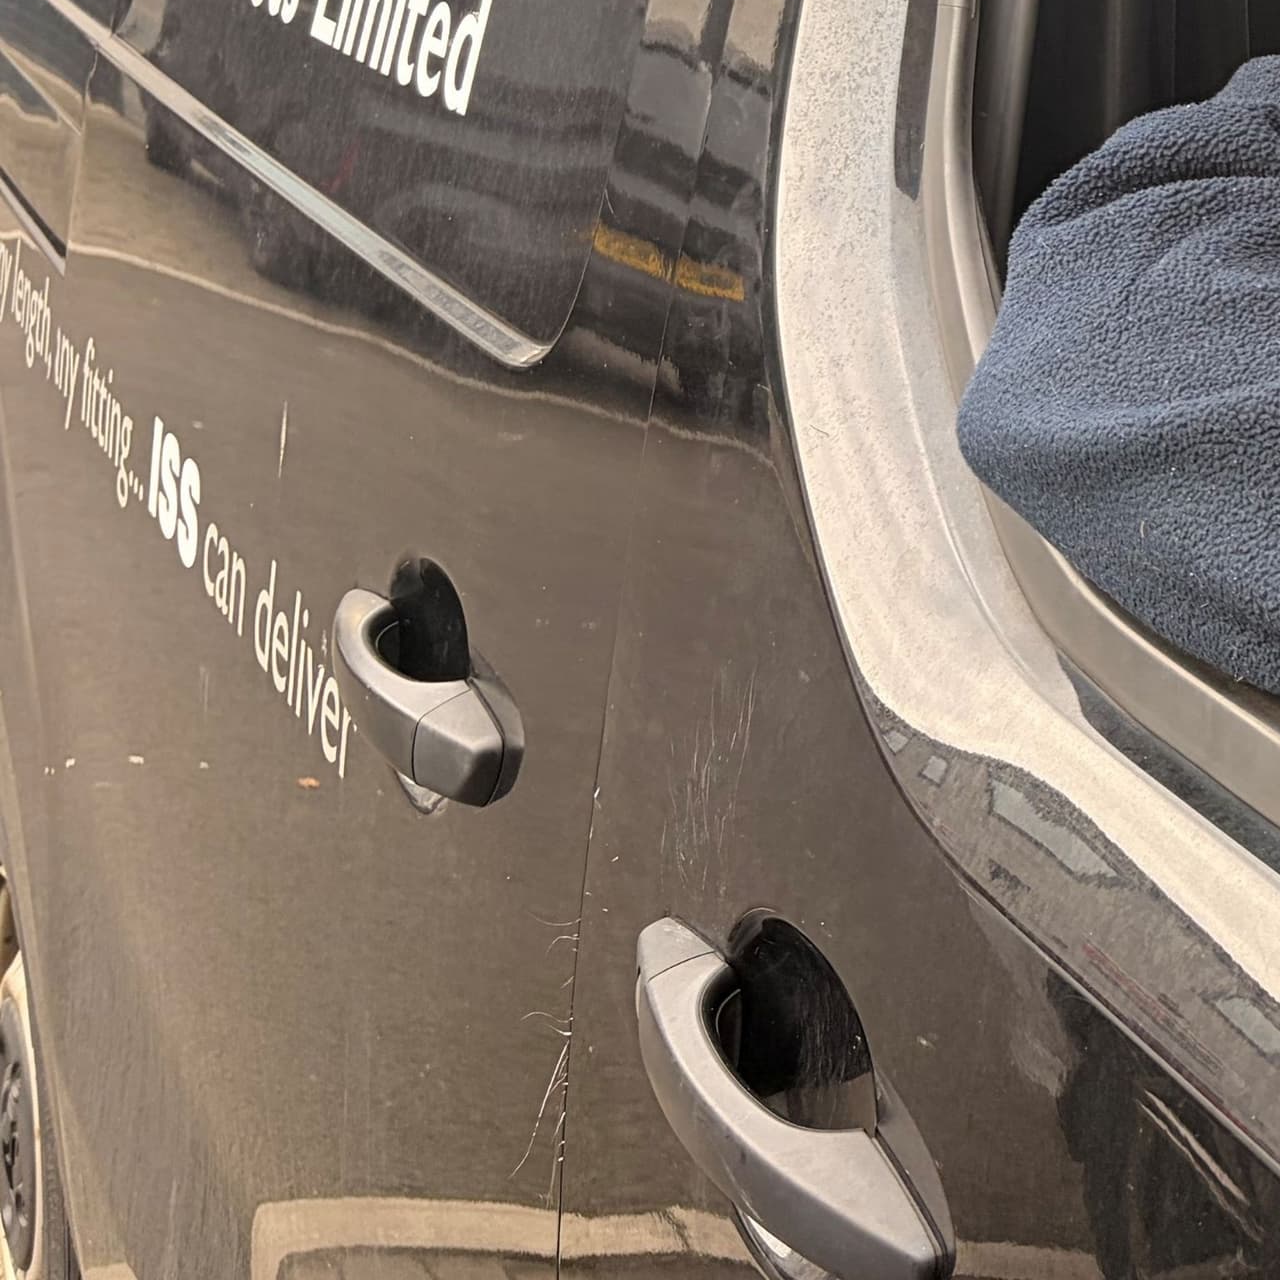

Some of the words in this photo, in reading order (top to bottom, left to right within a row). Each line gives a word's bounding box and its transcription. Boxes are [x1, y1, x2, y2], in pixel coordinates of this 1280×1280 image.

[11, 238, 52, 380] length,
[148, 415, 200, 568] ISS
[203, 523, 246, 637] can
